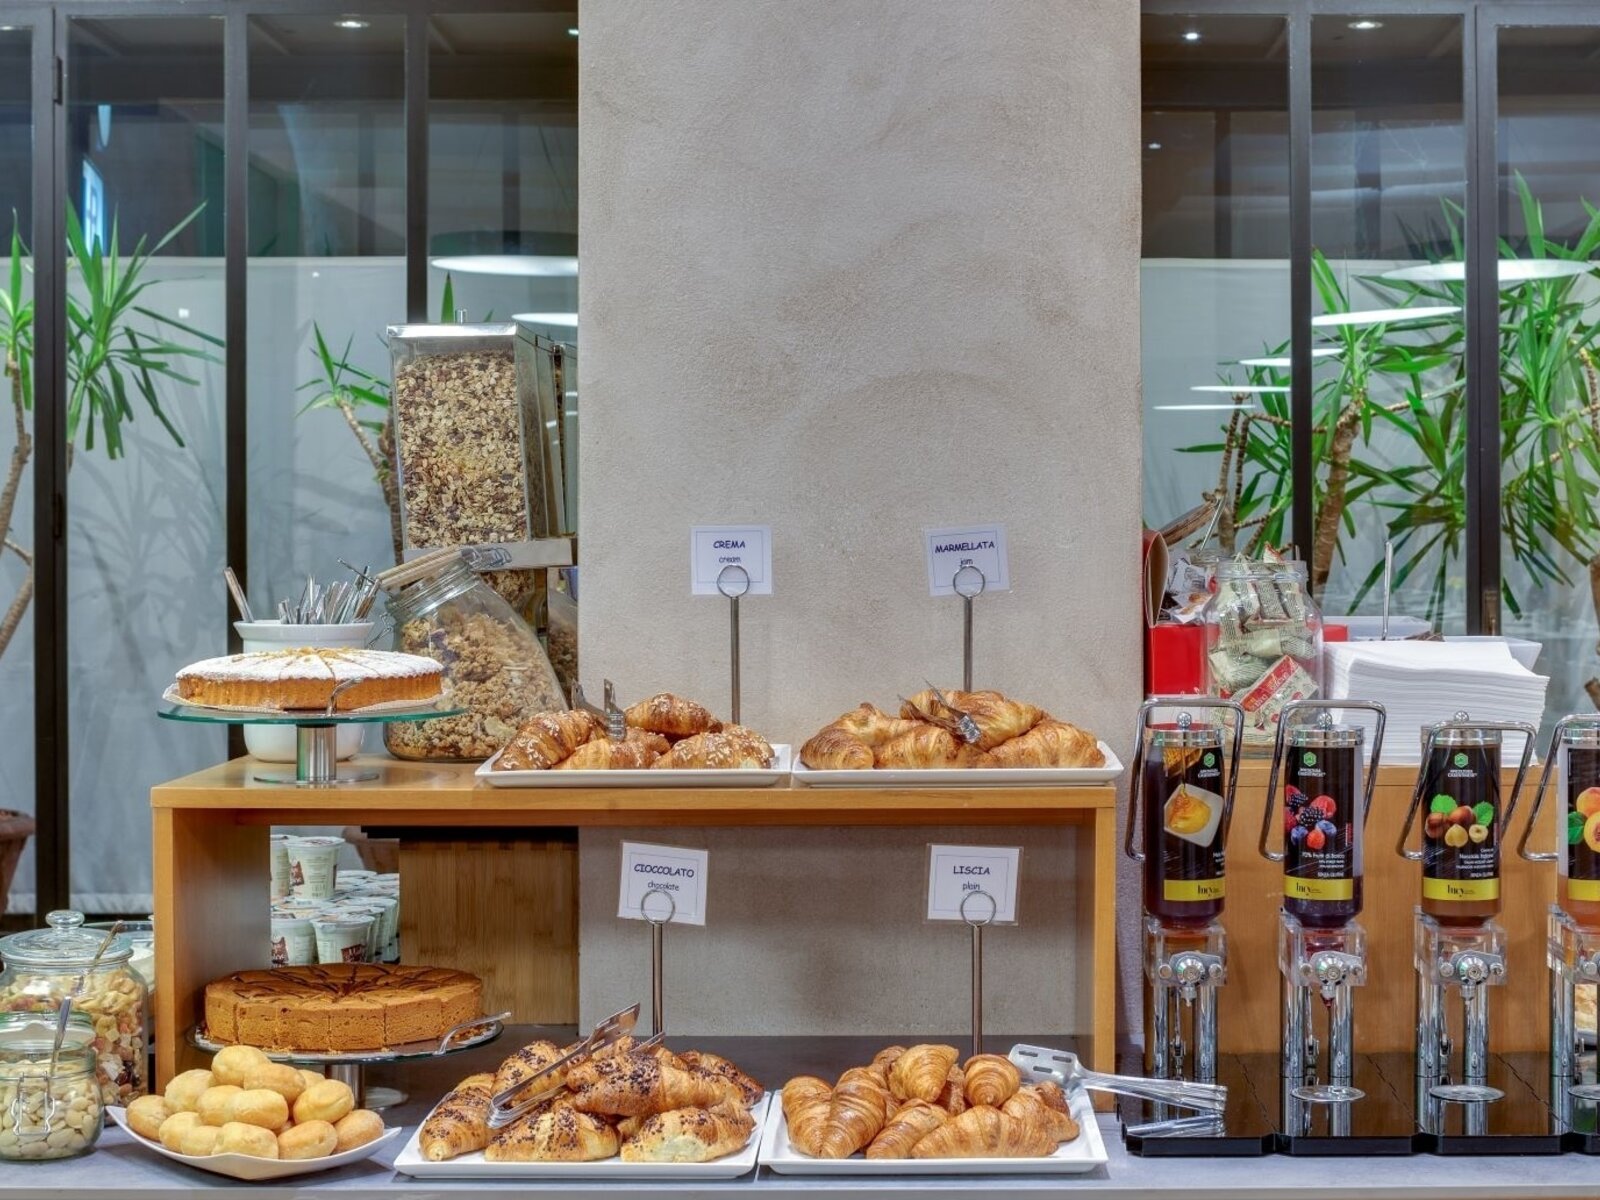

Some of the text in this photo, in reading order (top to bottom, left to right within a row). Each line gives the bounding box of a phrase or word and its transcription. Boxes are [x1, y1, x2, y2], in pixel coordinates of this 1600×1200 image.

[712, 540, 746, 549] CREMA
[934, 540, 995, 553] MARMELLATA
[959, 558, 974, 567] jam
[634, 863, 694, 878] CIOCCOLATO
[953, 865, 990, 875] LISCIA
[647, 880, 679, 891] chocolate
[962, 880, 980, 891] plain
